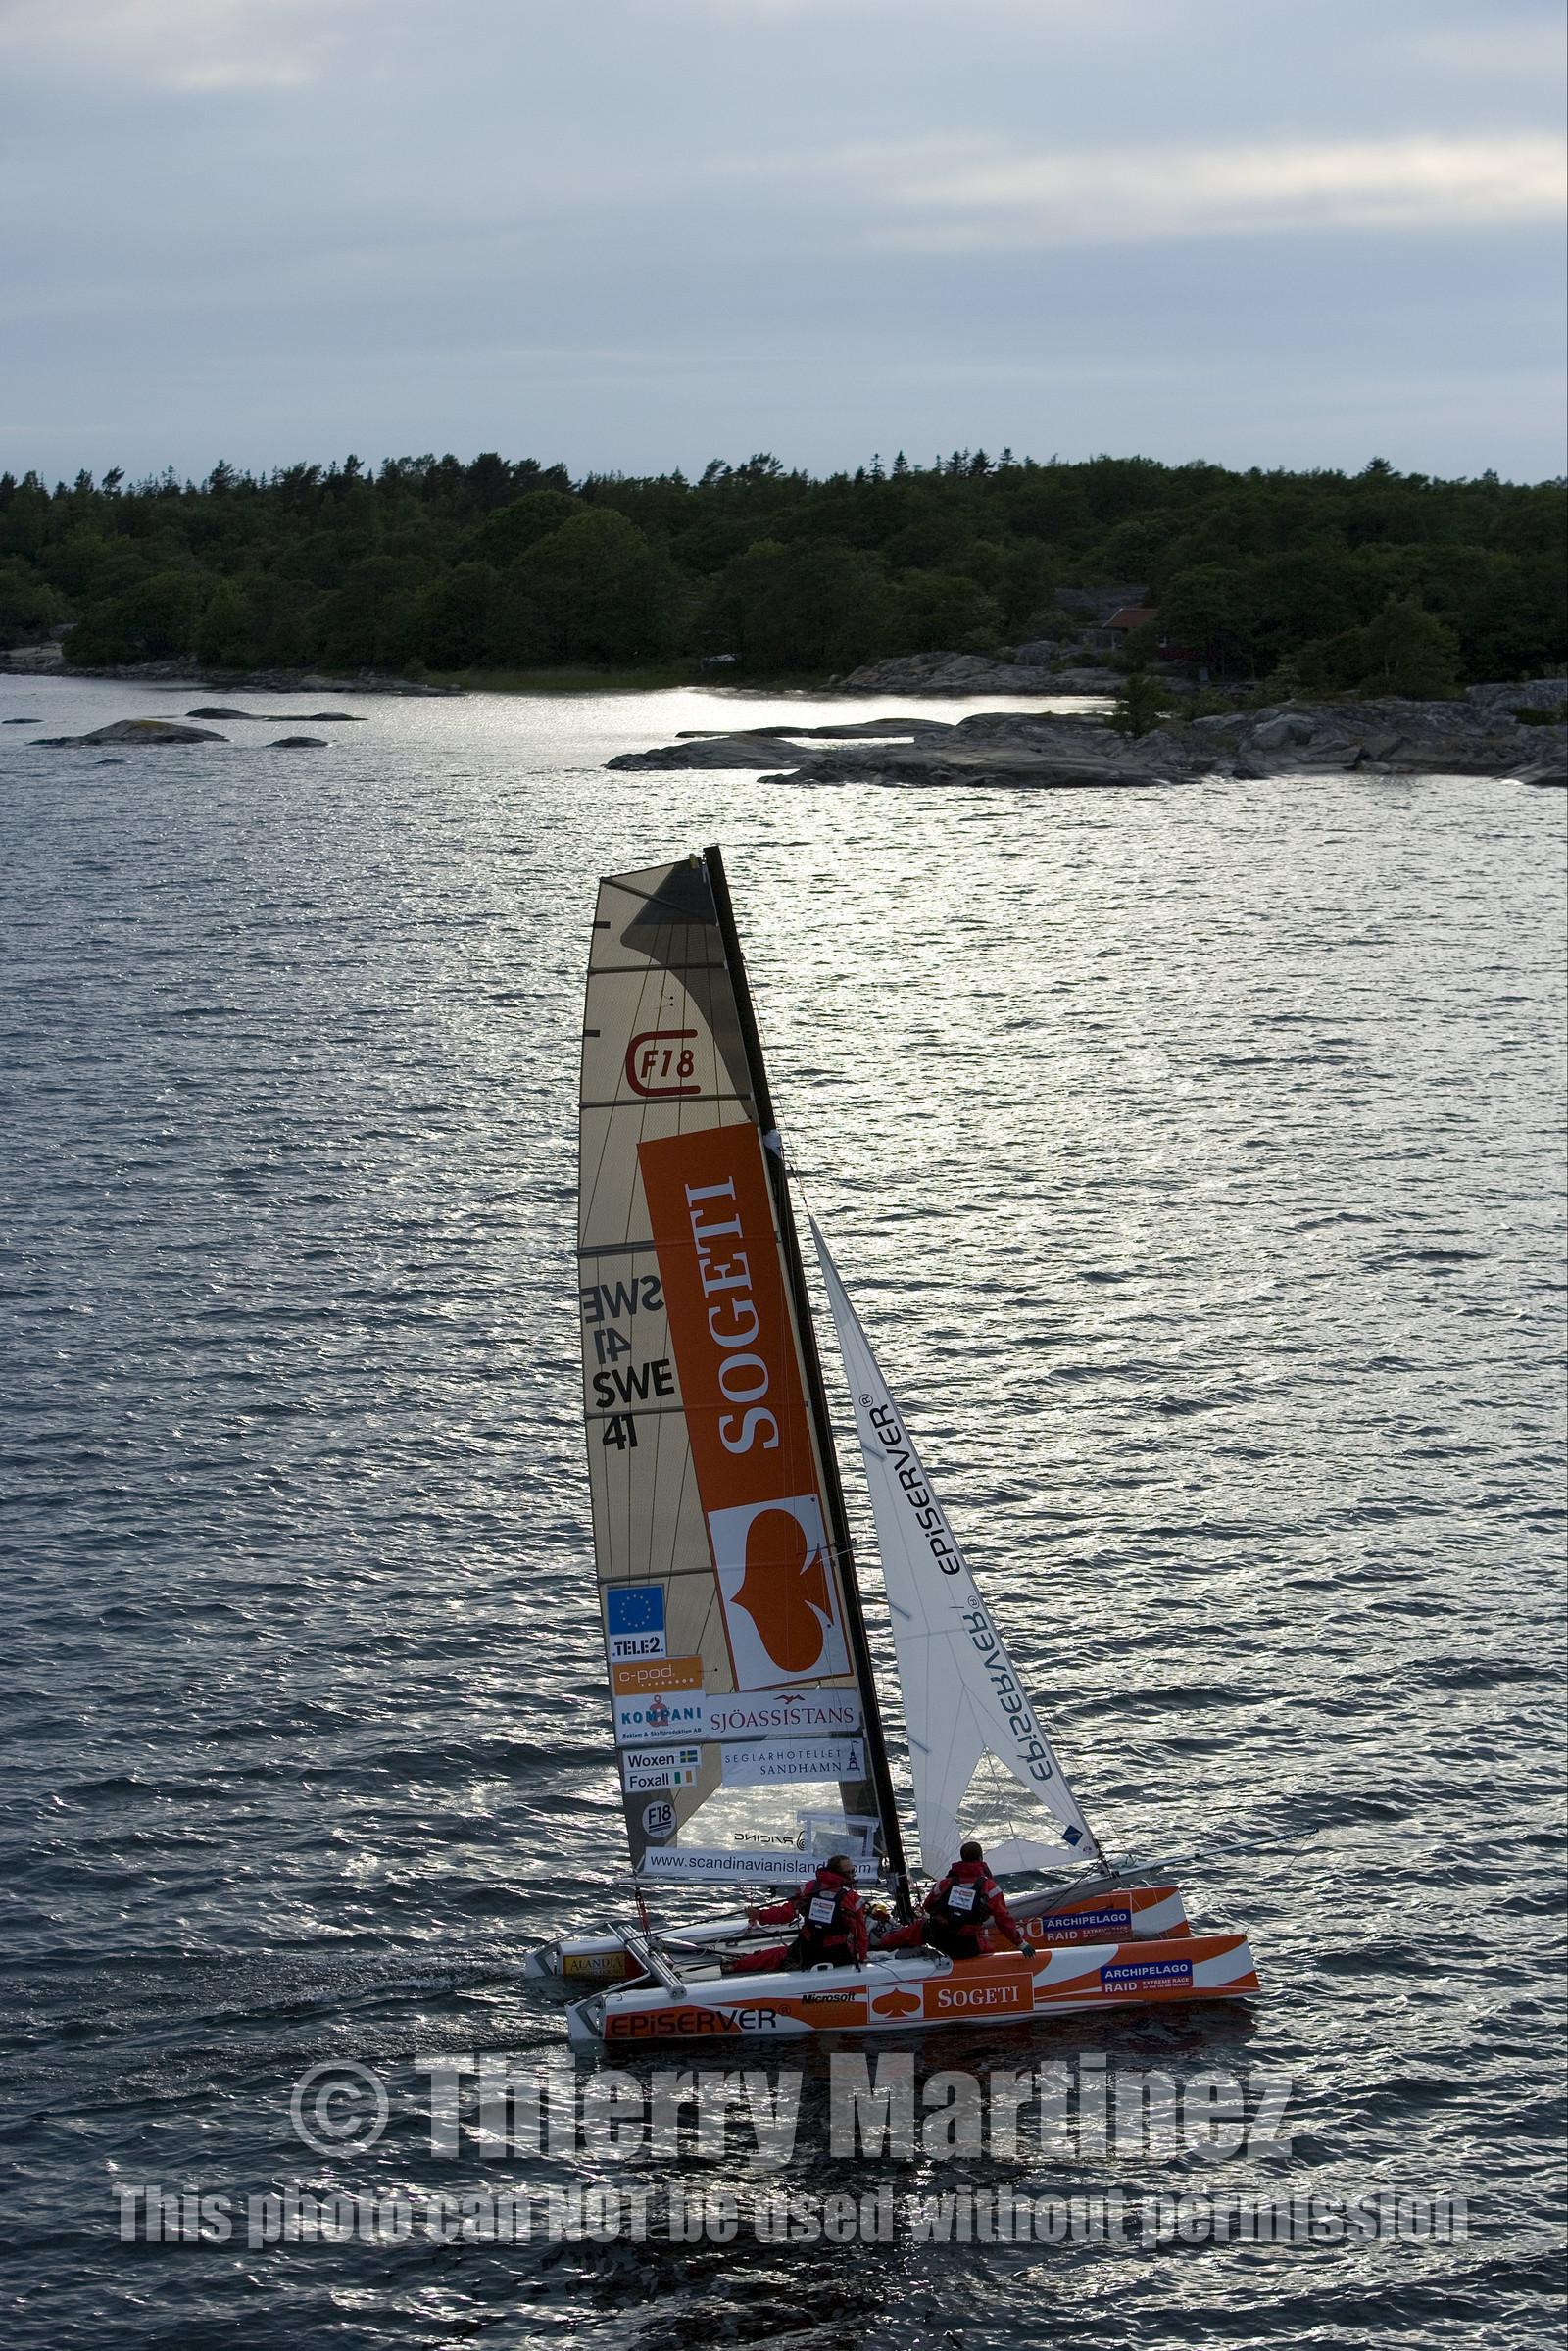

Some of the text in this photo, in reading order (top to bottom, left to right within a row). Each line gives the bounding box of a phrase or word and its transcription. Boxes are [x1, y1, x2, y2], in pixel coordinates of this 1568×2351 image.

[640, 1049, 695, 1079] F18
[685, 1175, 779, 1454] SOGETI
[592, 1358, 675, 1409] SWE
[602, 1412, 638, 1451] 41
[621, 1707, 702, 1725] KOMPANI
[710, 1705, 855, 1733] SJÖASSISTANS
[627, 1753, 675, 1768] Woxen
[725, 1749, 842, 1764] SEGLARHOTELLET
[760, 1762, 843, 1776] SANDHAMN
[629, 1773, 669, 1788] Foxall
[648, 1804, 671, 1825] F18
[1046, 1913, 1127, 1929] ARCHIPELAGO
[1047, 1931, 1078, 1941] RAID
[1104, 1964, 1189, 1979] ARCHIPELAGO
[1104, 1982, 1138, 1993] RAID
[802, 1991, 856, 2004] Microsoft
[937, 1985, 1019, 2009] SOGETI
